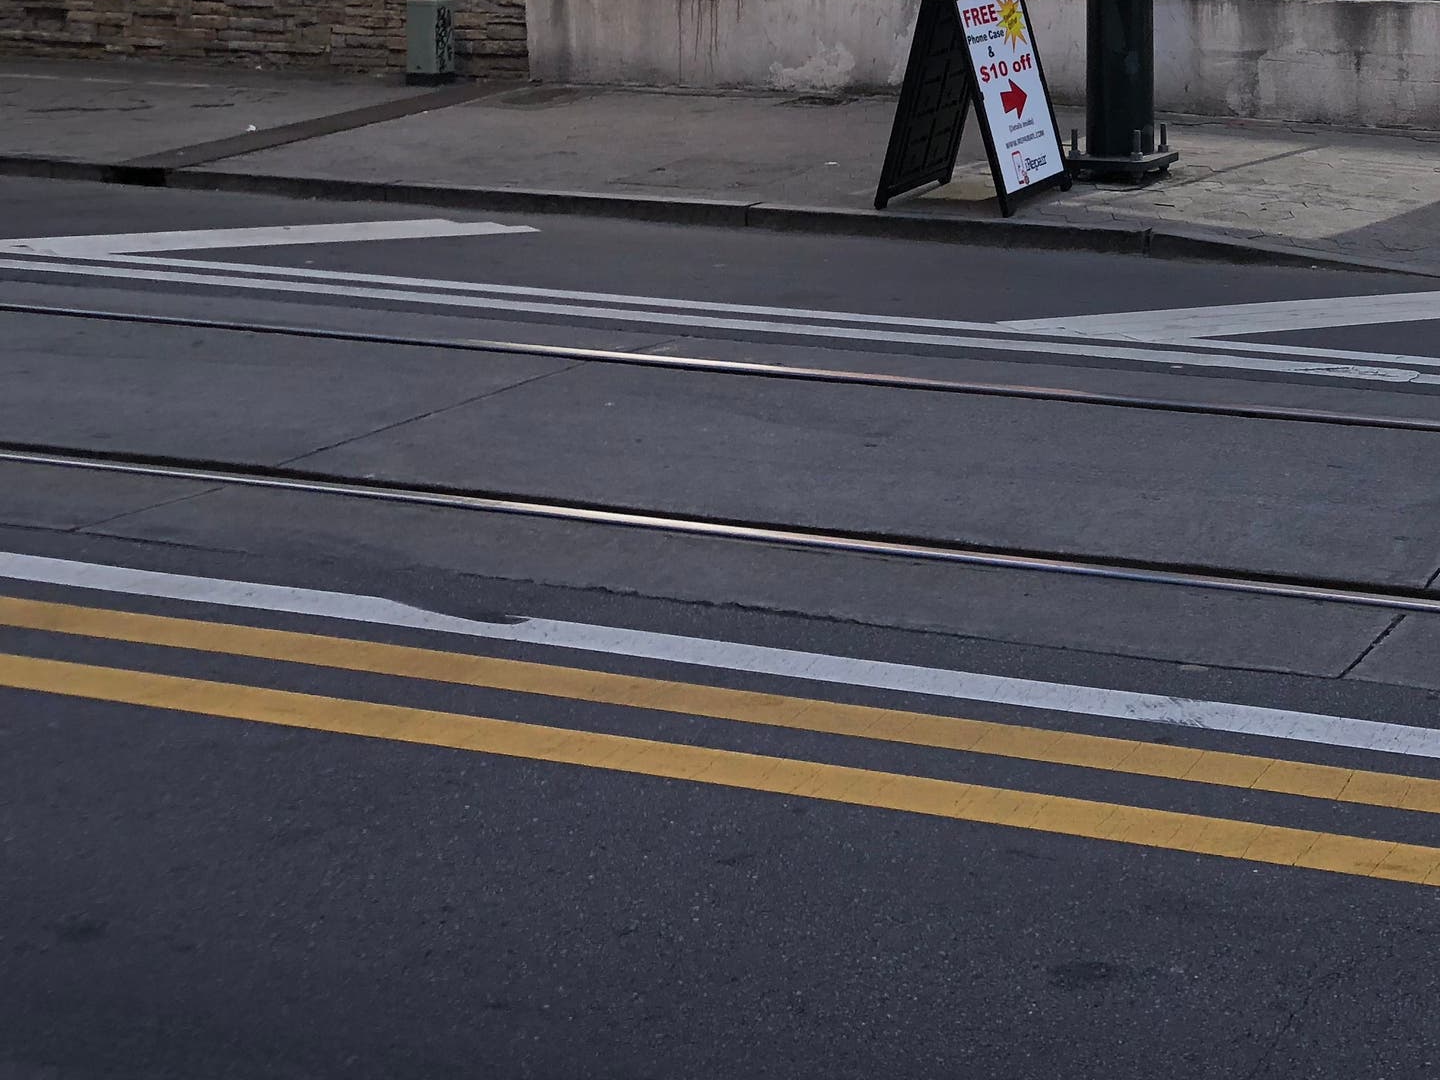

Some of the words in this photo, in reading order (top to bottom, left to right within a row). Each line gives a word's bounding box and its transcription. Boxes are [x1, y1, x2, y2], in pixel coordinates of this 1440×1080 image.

[963, 4, 998, 28] FREE
[967, 33, 989, 45] Phone
[988, 29, 1005, 40] Case
[987, 45, 995, 58] &
[980, 60, 1008, 83] $10
[1012, 53, 1032, 72] off
